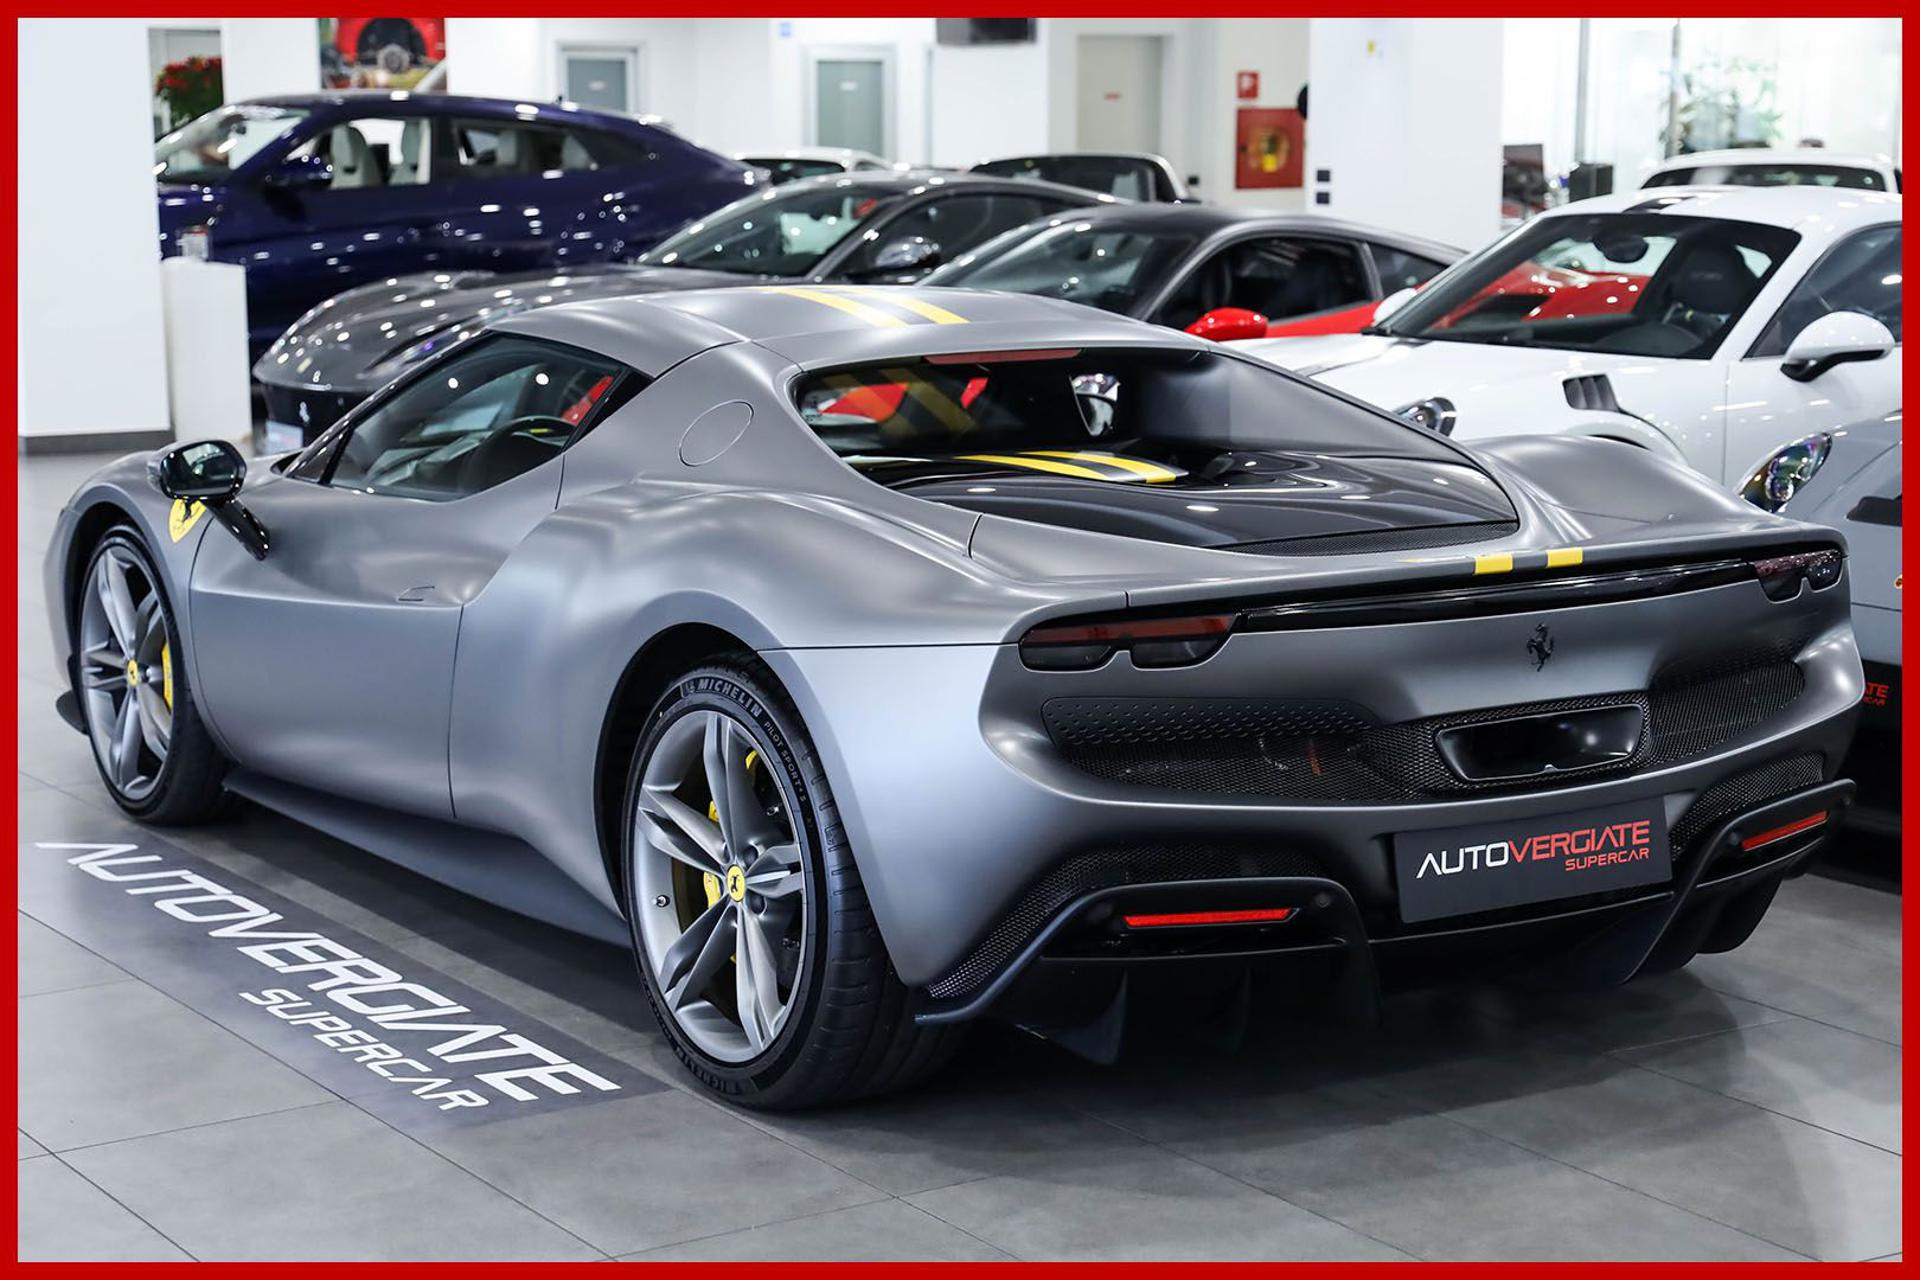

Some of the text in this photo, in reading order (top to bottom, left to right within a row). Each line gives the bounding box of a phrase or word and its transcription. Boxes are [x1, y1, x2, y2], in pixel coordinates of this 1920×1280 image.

[698, 678, 763, 717] MICHELIN
[764, 721, 785, 747] PILOT
[781, 750, 801, 786] SPORT
[1416, 820, 1650, 879] AUTOVERGIATE
[1565, 848, 1650, 871] SUPERCAR
[34, 842, 621, 1102] AUTOVERGIATE
[238, 988, 489, 1111] SUPERCAR
